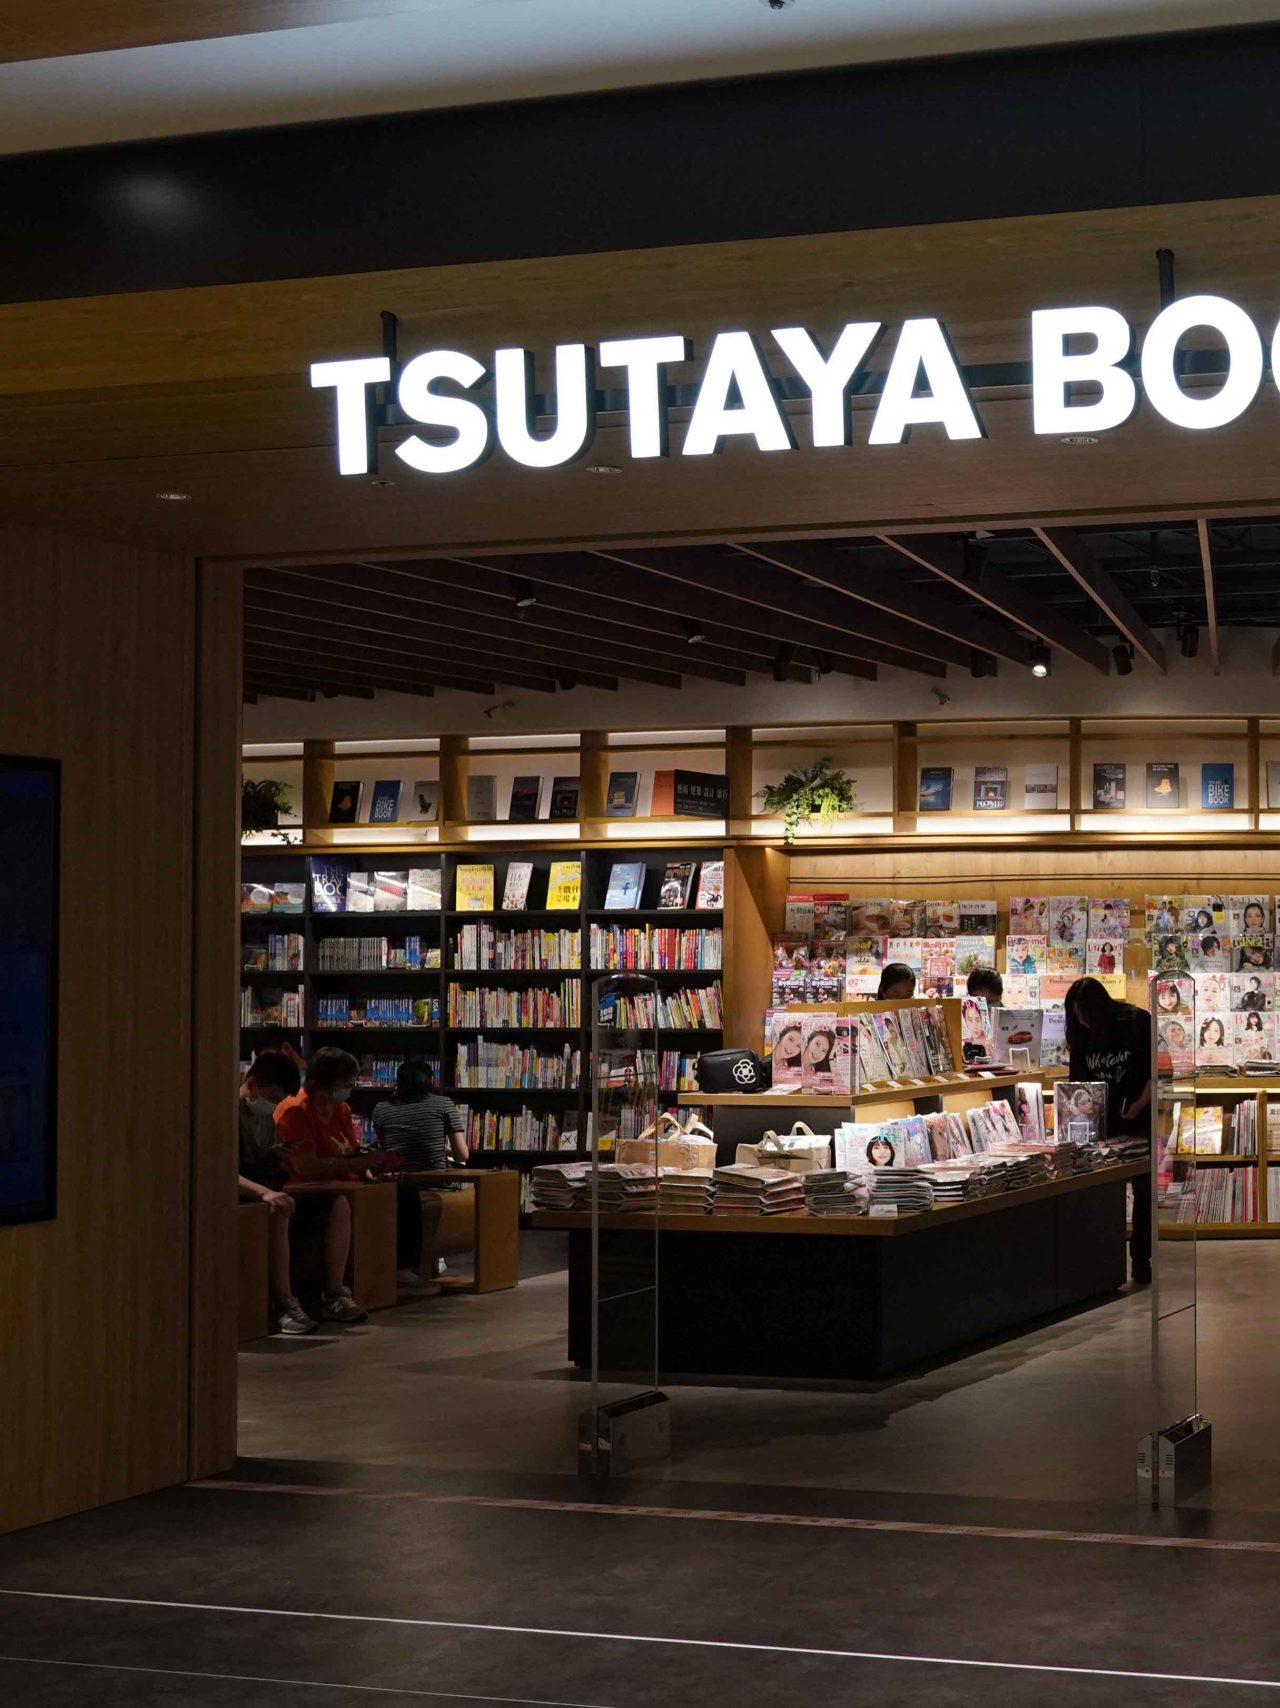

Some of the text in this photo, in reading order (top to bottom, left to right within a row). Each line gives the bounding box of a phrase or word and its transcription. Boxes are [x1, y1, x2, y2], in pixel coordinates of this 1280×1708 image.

[309, 317, 984, 477] TSUTAYA
[1208, 784, 1230, 797] BIKE
[375, 799, 395, 811] BIKE
[1208, 796, 1229, 804] BOOK
[374, 810, 392, 818] BOOK
[1086, 1050, 1131, 1069] Whatever
